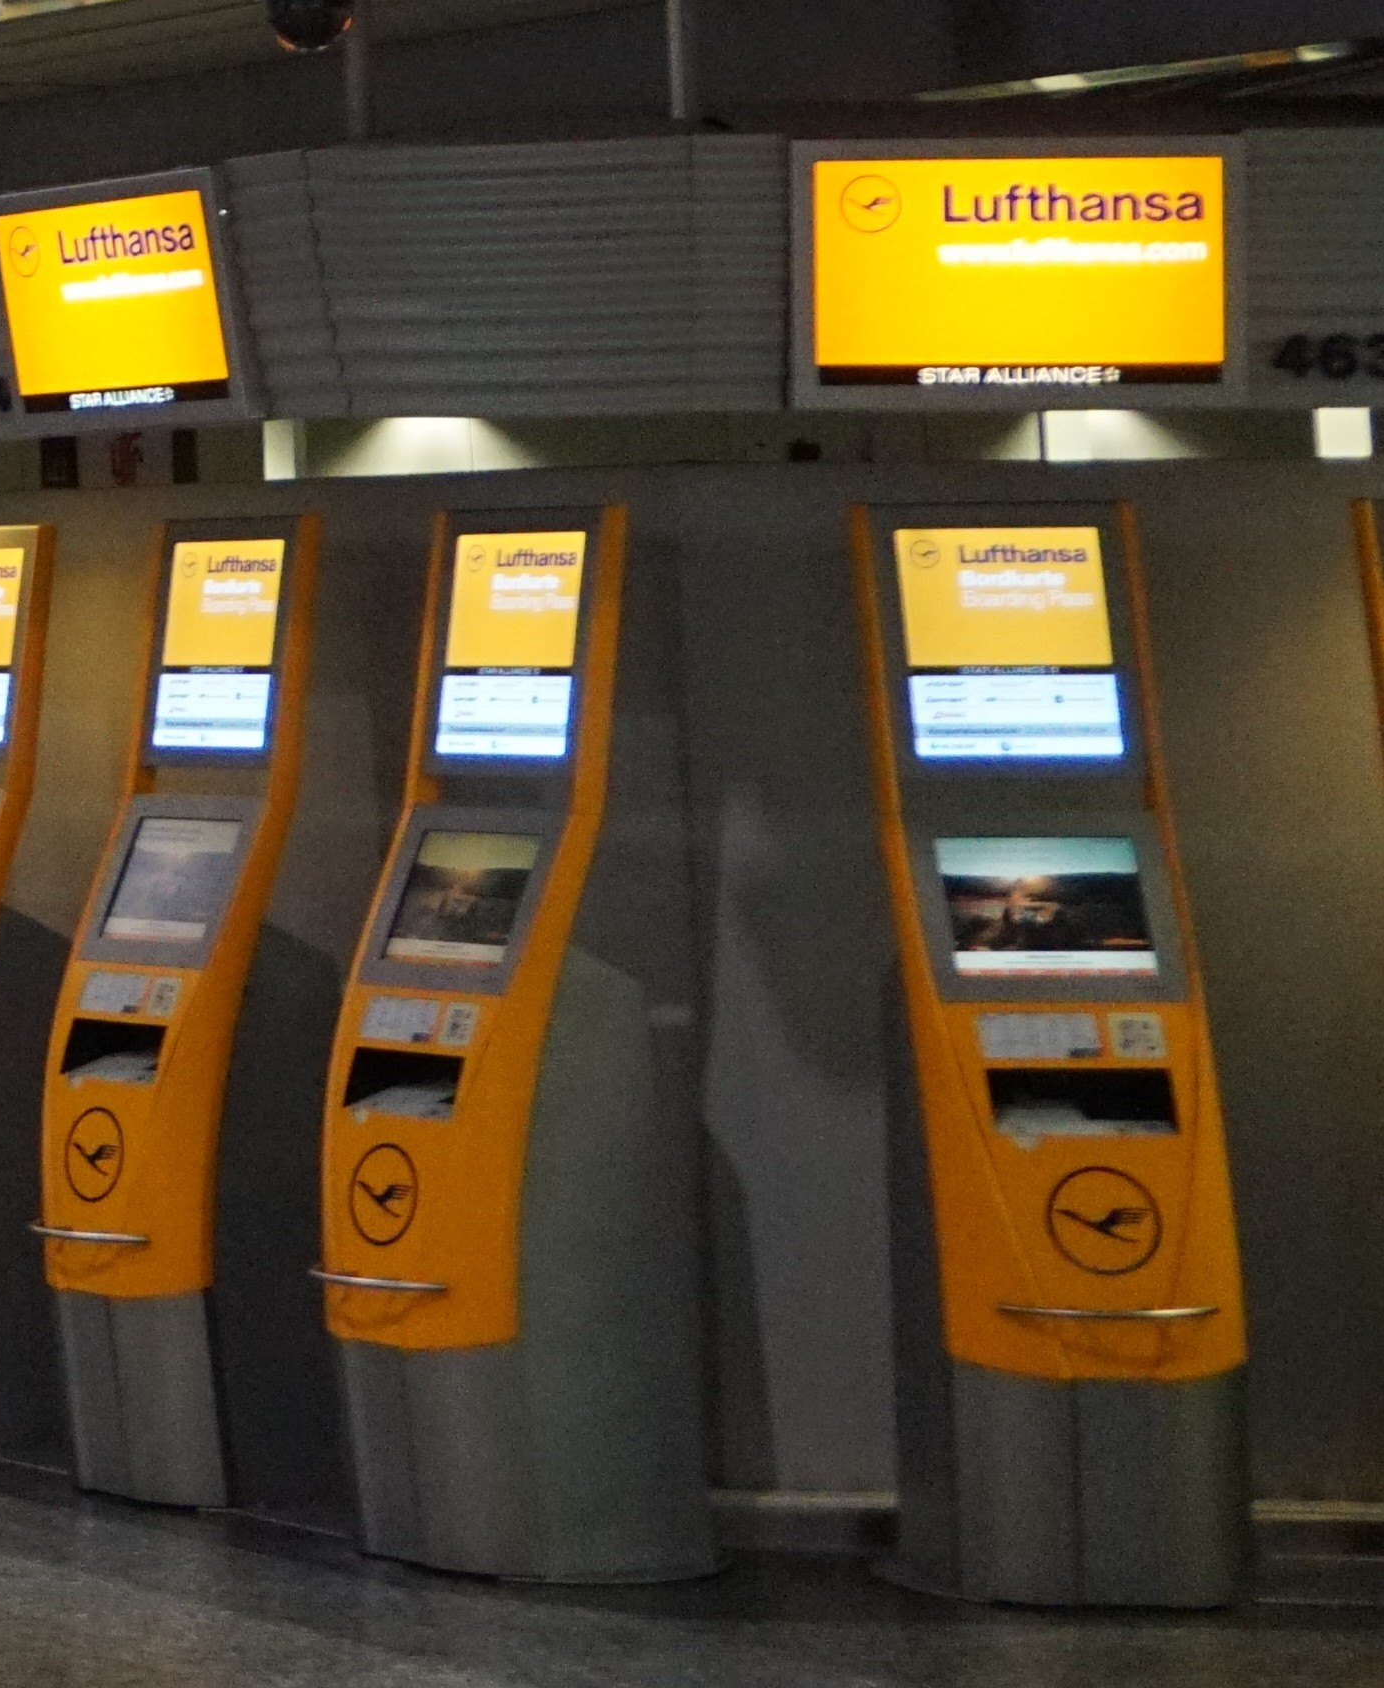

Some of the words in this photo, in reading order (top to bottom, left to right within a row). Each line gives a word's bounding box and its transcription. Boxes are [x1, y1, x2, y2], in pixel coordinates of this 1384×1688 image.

[942, 183, 1206, 225] Lufthansa
[56, 220, 196, 266] Lufthansa
[917, 366, 981, 386] STAR
[985, 365, 1103, 385] ALLIANCE
[68, 389, 102, 410] STAR
[102, 386, 166, 408] ALLIANCE
[206, 553, 278, 576] Lufthansa
[494, 547, 577, 570] Lufthansa
[956, 543, 1088, 564] Lufthansa
